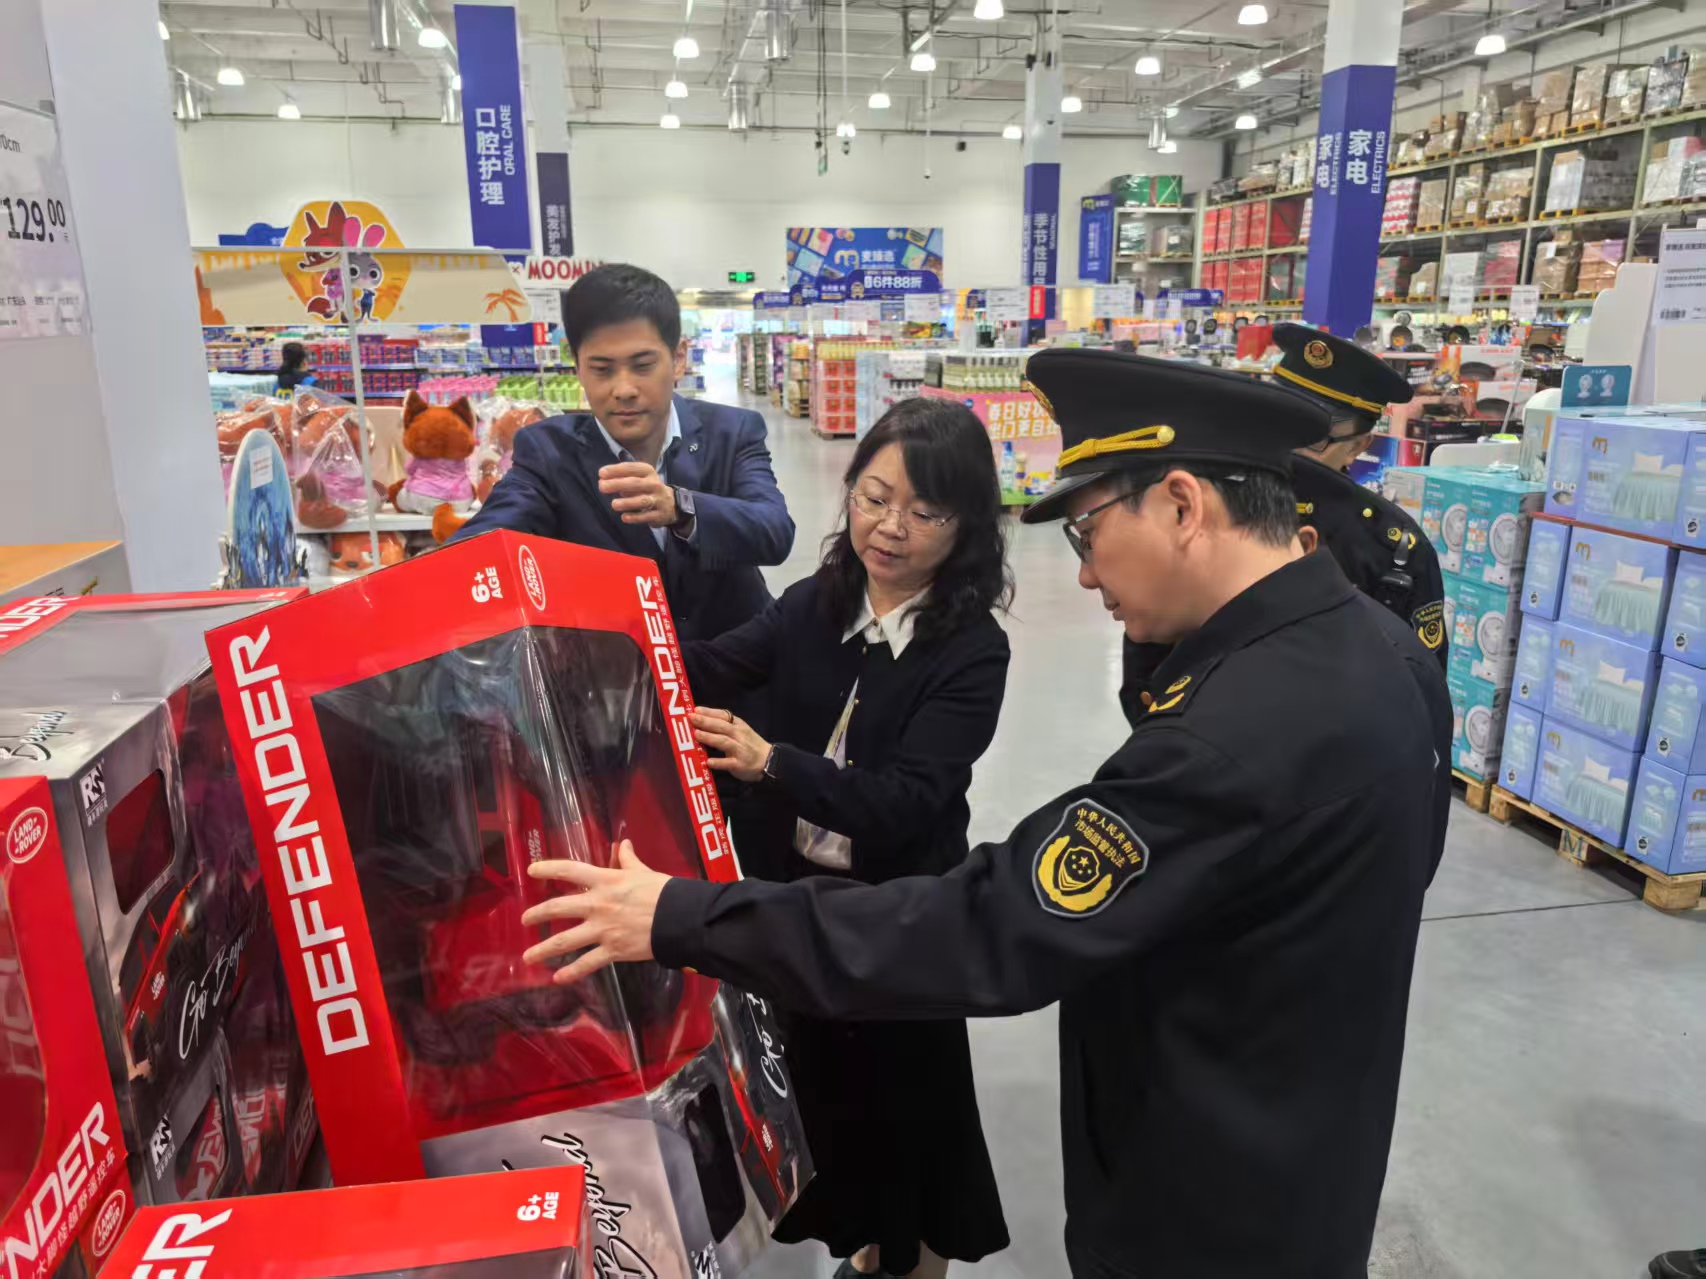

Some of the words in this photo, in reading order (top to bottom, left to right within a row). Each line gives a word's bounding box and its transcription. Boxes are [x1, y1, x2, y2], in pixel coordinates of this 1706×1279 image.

[500, 103, 512, 139] CARE
[475, 108, 505, 205] 口腔护理
[503, 141, 515, 176] ORAL
[1316, 134, 1334, 188] 家电
[1345, 129, 1373, 185] 家电
[1371, 131, 1386, 193] ELECTRICS
[6, 197, 66, 243] 129.00
[472, 571, 490, 602] 6+
[485, 566, 503, 598] AGE
[635, 575, 723, 860] DEFENDER
[14, 818, 34, 844] LAND
[19, 827, 41, 855] ROVER
[229, 625, 370, 1056] DEFENDER
[1074, 820, 1126, 868] 市场监管执法
[1077, 808, 1141, 865] 中华人民共和国
[0, 1102, 110, 1279] NDER
[32, 1147, 115, 1279] 大脚怪越野遥控车
[517, 1194, 543, 1221] 6+
[542, 1192, 559, 1220] AGE
